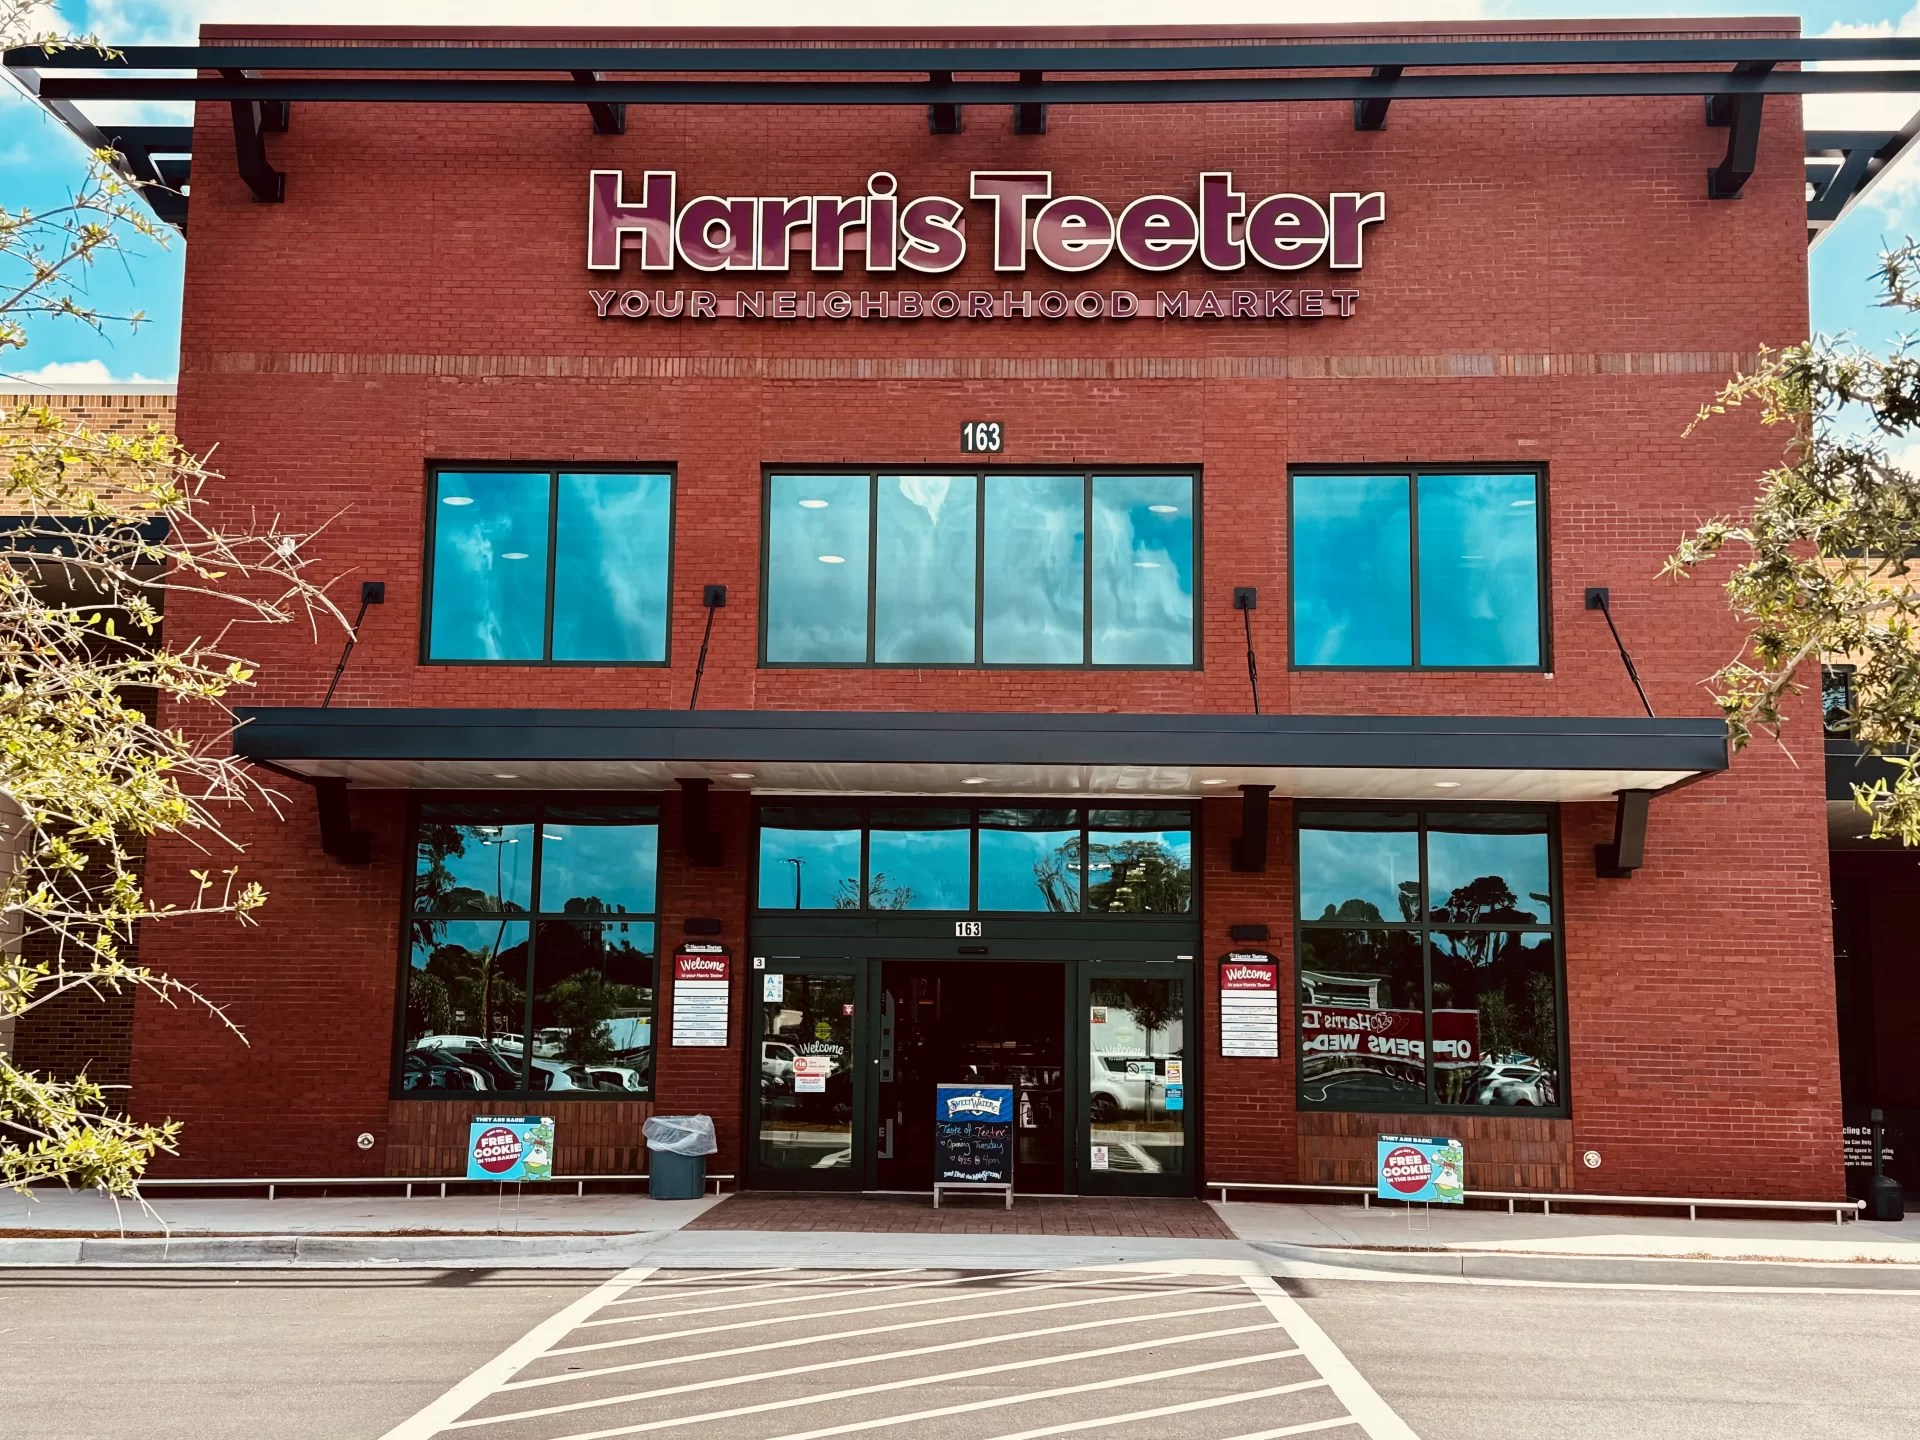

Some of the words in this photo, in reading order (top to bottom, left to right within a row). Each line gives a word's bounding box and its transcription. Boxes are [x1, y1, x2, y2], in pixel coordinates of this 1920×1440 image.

[587, 169, 967, 272] Harris
[970, 170, 1386, 271] Teeter
[588, 290, 718, 318] YOUR
[736, 290, 1140, 319] NEIGHBORHOOD
[1156, 289, 1360, 318] MARKET
[964, 422, 1001, 451] 163
[957, 922, 980, 936] 163
[680, 957, 725, 971] Welcome
[756, 959, 763, 967] 3
[1226, 966, 1272, 981] Welcome
[799, 1040, 844, 1055] Welcome
[964, 1123, 972, 1136] of
[1842, 1127, 1860, 1135] cling
[481, 1134, 513, 1147] FREE
[947, 1139, 971, 1156] Opening
[973, 1139, 1004, 1154] Tuesday
[473, 1143, 522, 1158] COOKIE
[983, 1154, 1000, 1166] 4pm
[1389, 1155, 1422, 1166] FREE
[1382, 1164, 1432, 1177] COOKIE
